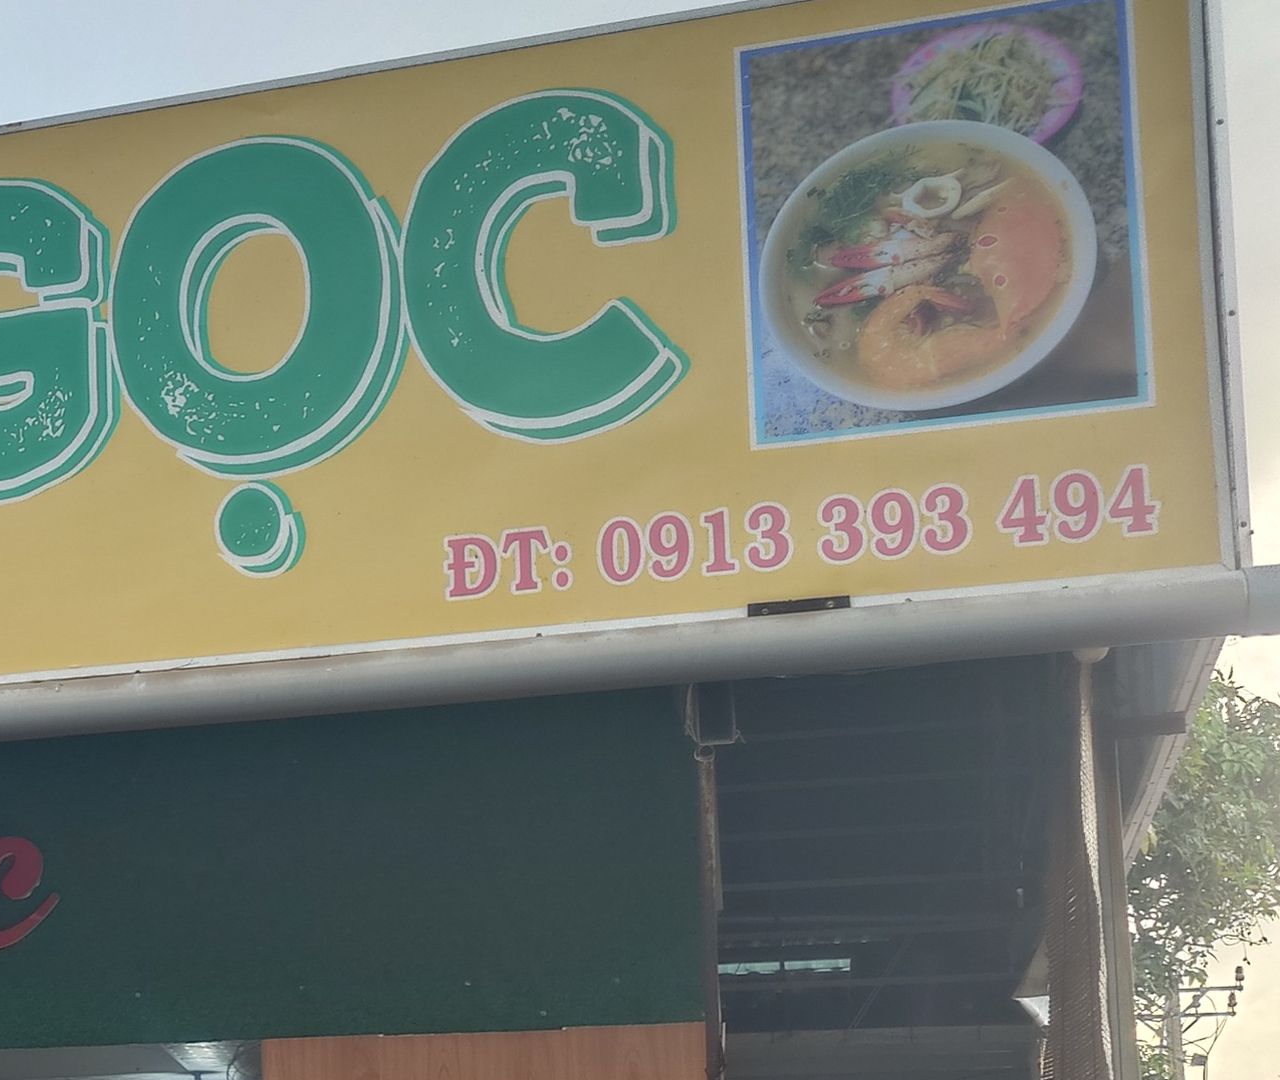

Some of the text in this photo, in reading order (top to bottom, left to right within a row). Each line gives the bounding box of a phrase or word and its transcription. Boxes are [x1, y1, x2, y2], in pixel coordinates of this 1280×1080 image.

[444, 464, 1160, 600] ĐT: 0913 393 494
